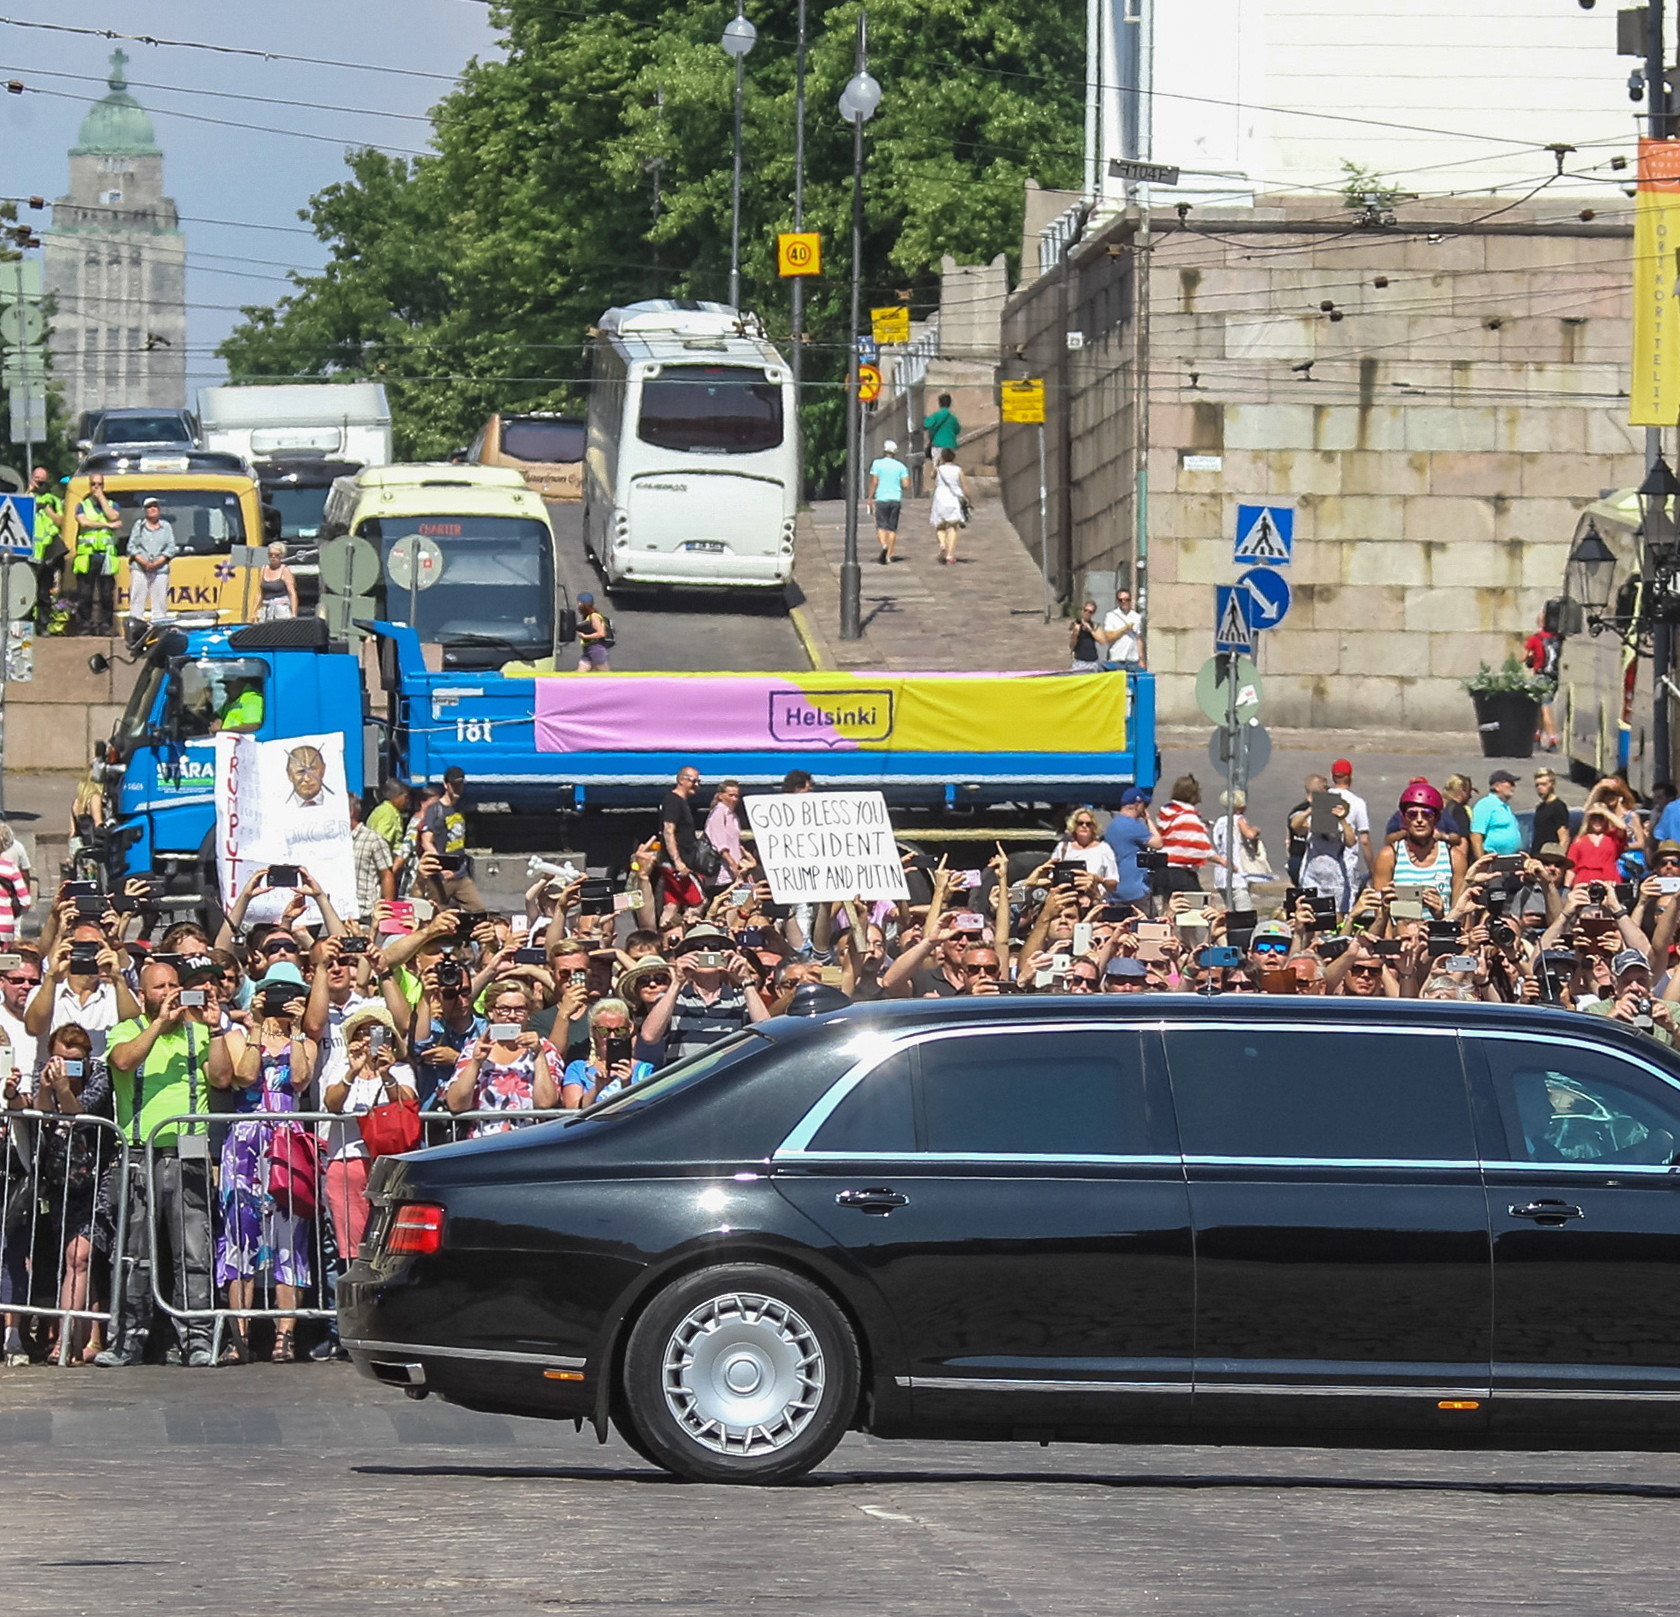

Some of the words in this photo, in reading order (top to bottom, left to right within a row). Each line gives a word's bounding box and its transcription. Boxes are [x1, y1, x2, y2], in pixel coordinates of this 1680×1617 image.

[790, 247, 807, 261] 40
[418, 523, 462, 536] CHARTER
[786, 707, 877, 726] Helsinki
[751, 802, 795, 828] GOD
[802, 799, 851, 826] BLESS
[855, 800, 885, 824] YOU
[768, 831, 885, 859] PRESIDENT
[768, 865, 821, 891] TRUMP
[826, 865, 854, 889] AND
[857, 863, 904, 890] PUTIN
